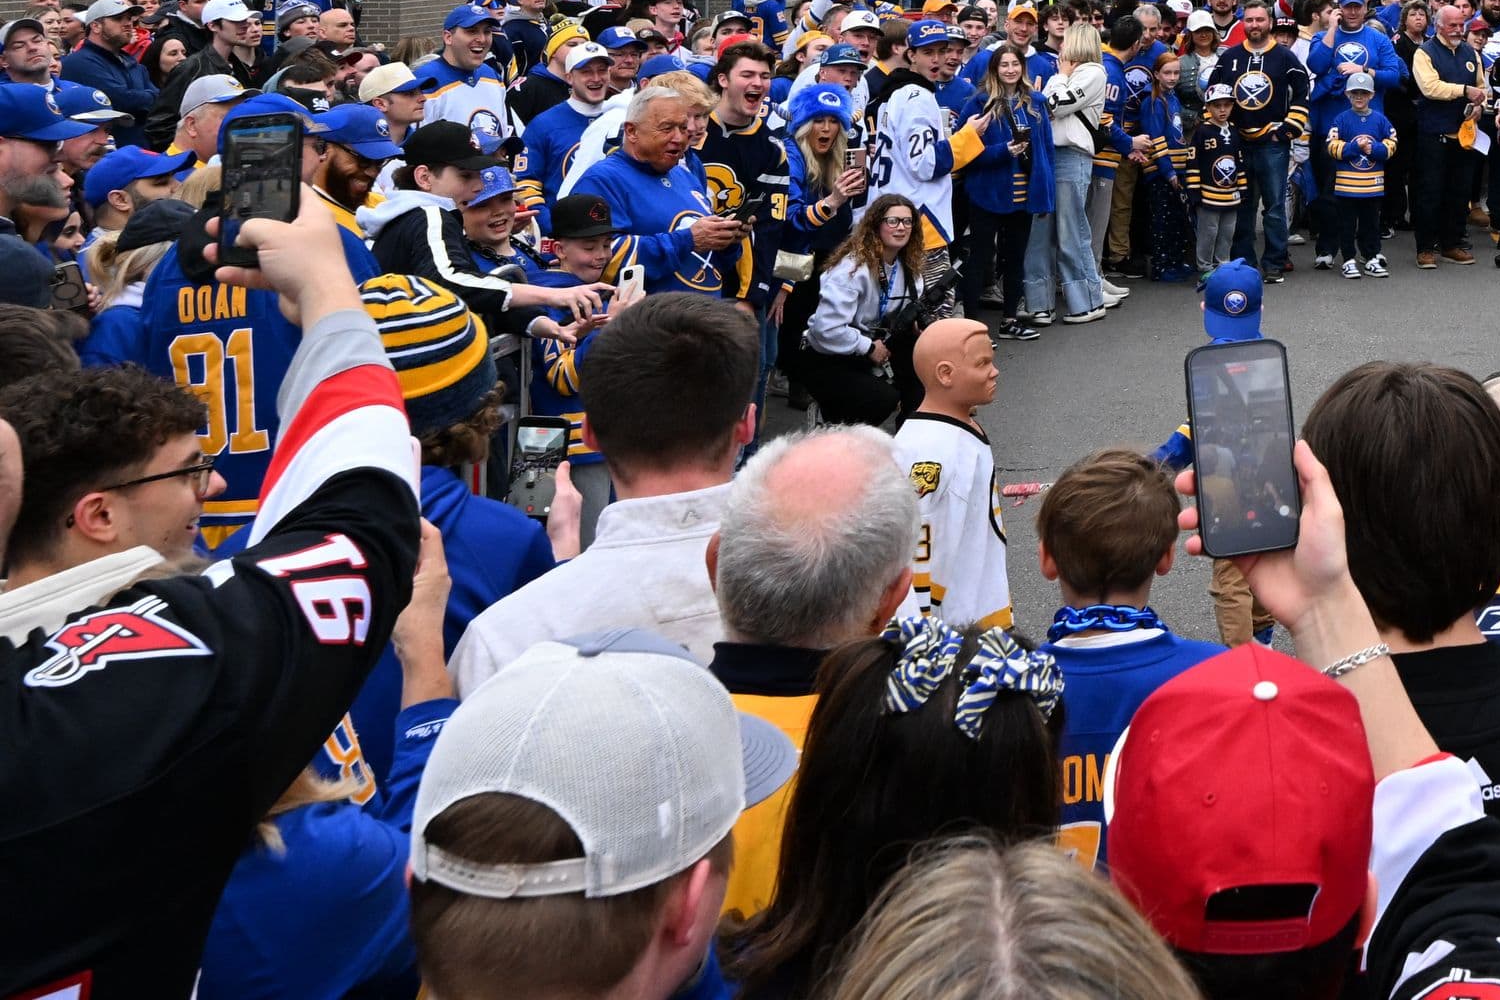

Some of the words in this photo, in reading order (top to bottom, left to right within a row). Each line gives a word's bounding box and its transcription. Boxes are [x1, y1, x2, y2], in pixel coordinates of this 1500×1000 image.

[1231, 59, 1237, 71] 1
[1104, 82, 1119, 101] 10
[1205, 138, 1217, 150] 53
[168, 328, 270, 456] 91
[257, 533, 372, 645] 16
